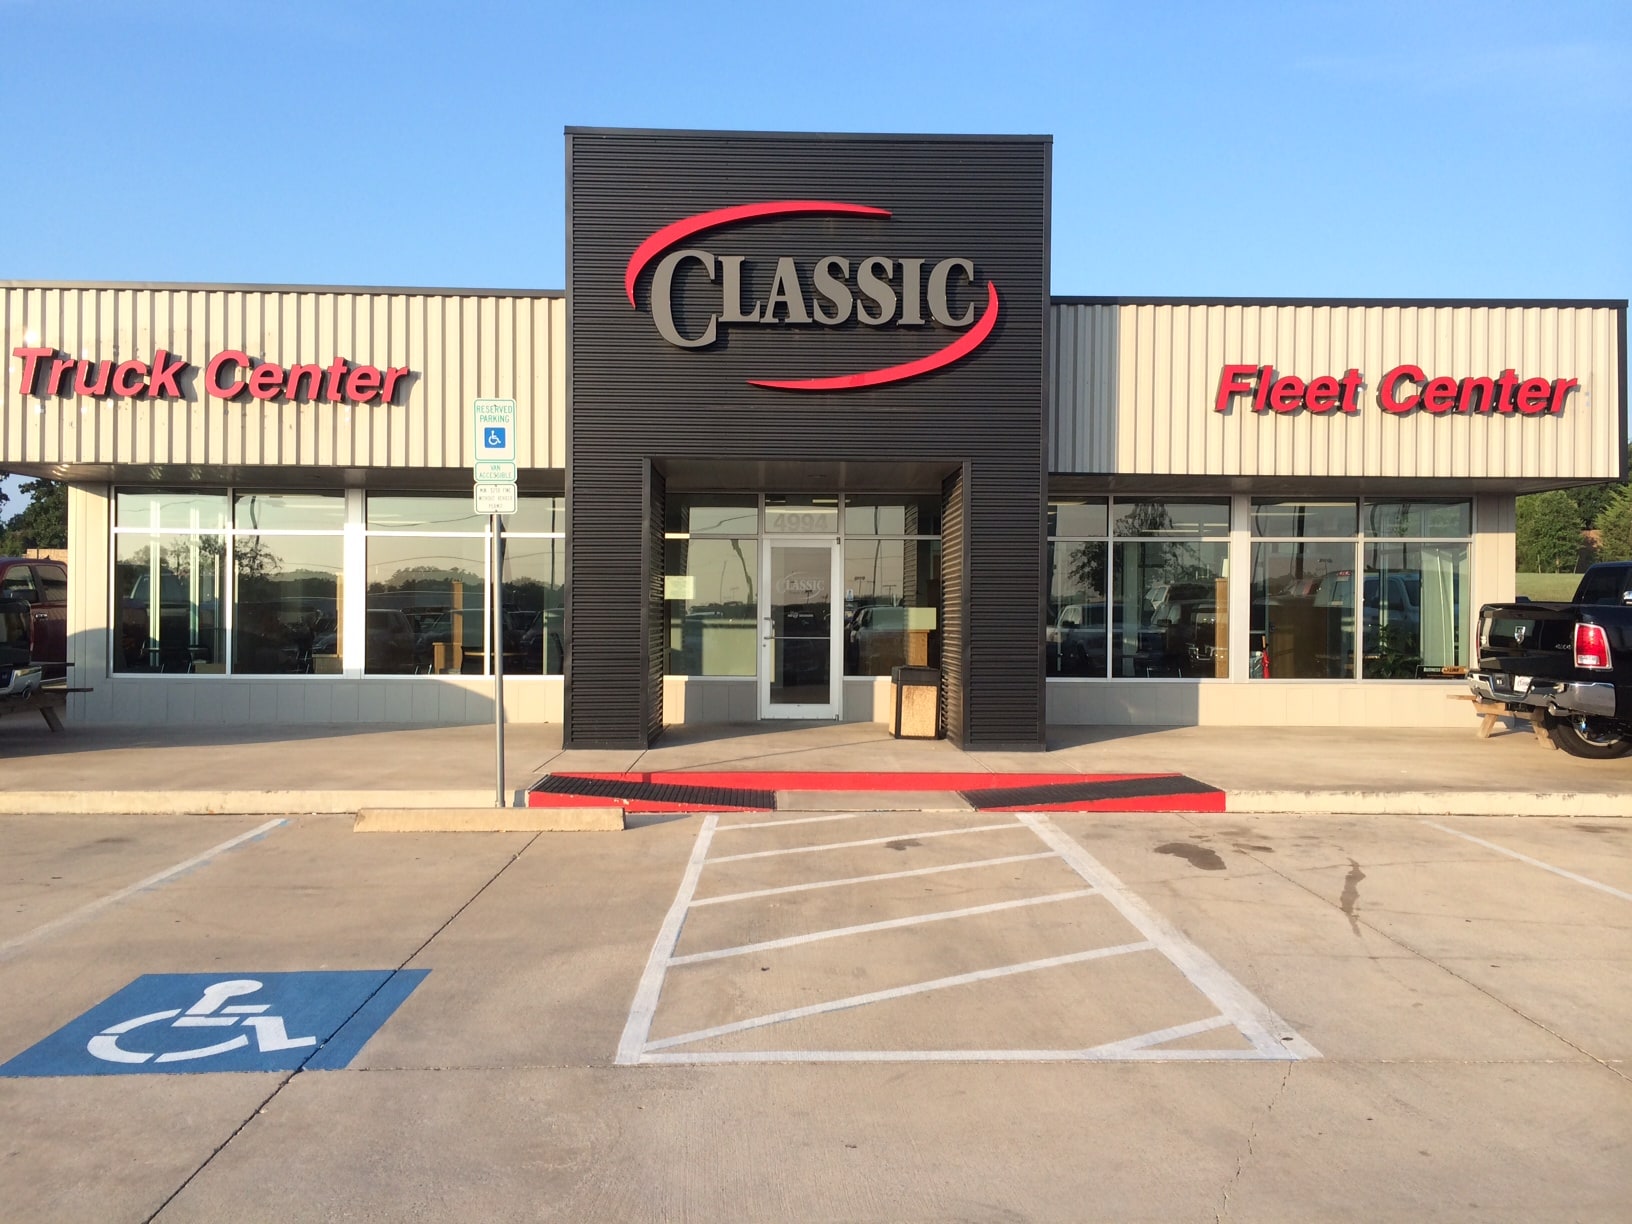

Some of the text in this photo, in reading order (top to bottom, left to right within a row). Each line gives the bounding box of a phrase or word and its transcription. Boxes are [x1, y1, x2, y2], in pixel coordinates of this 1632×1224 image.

[650, 249, 975, 348] CLASSIC
[12, 346, 409, 402] Truck Center
[1214, 364, 1578, 414] Fleet Center
[476, 404, 513, 414] RESERVED
[479, 414, 510, 423] PARKING
[773, 512, 829, 532] 4994
